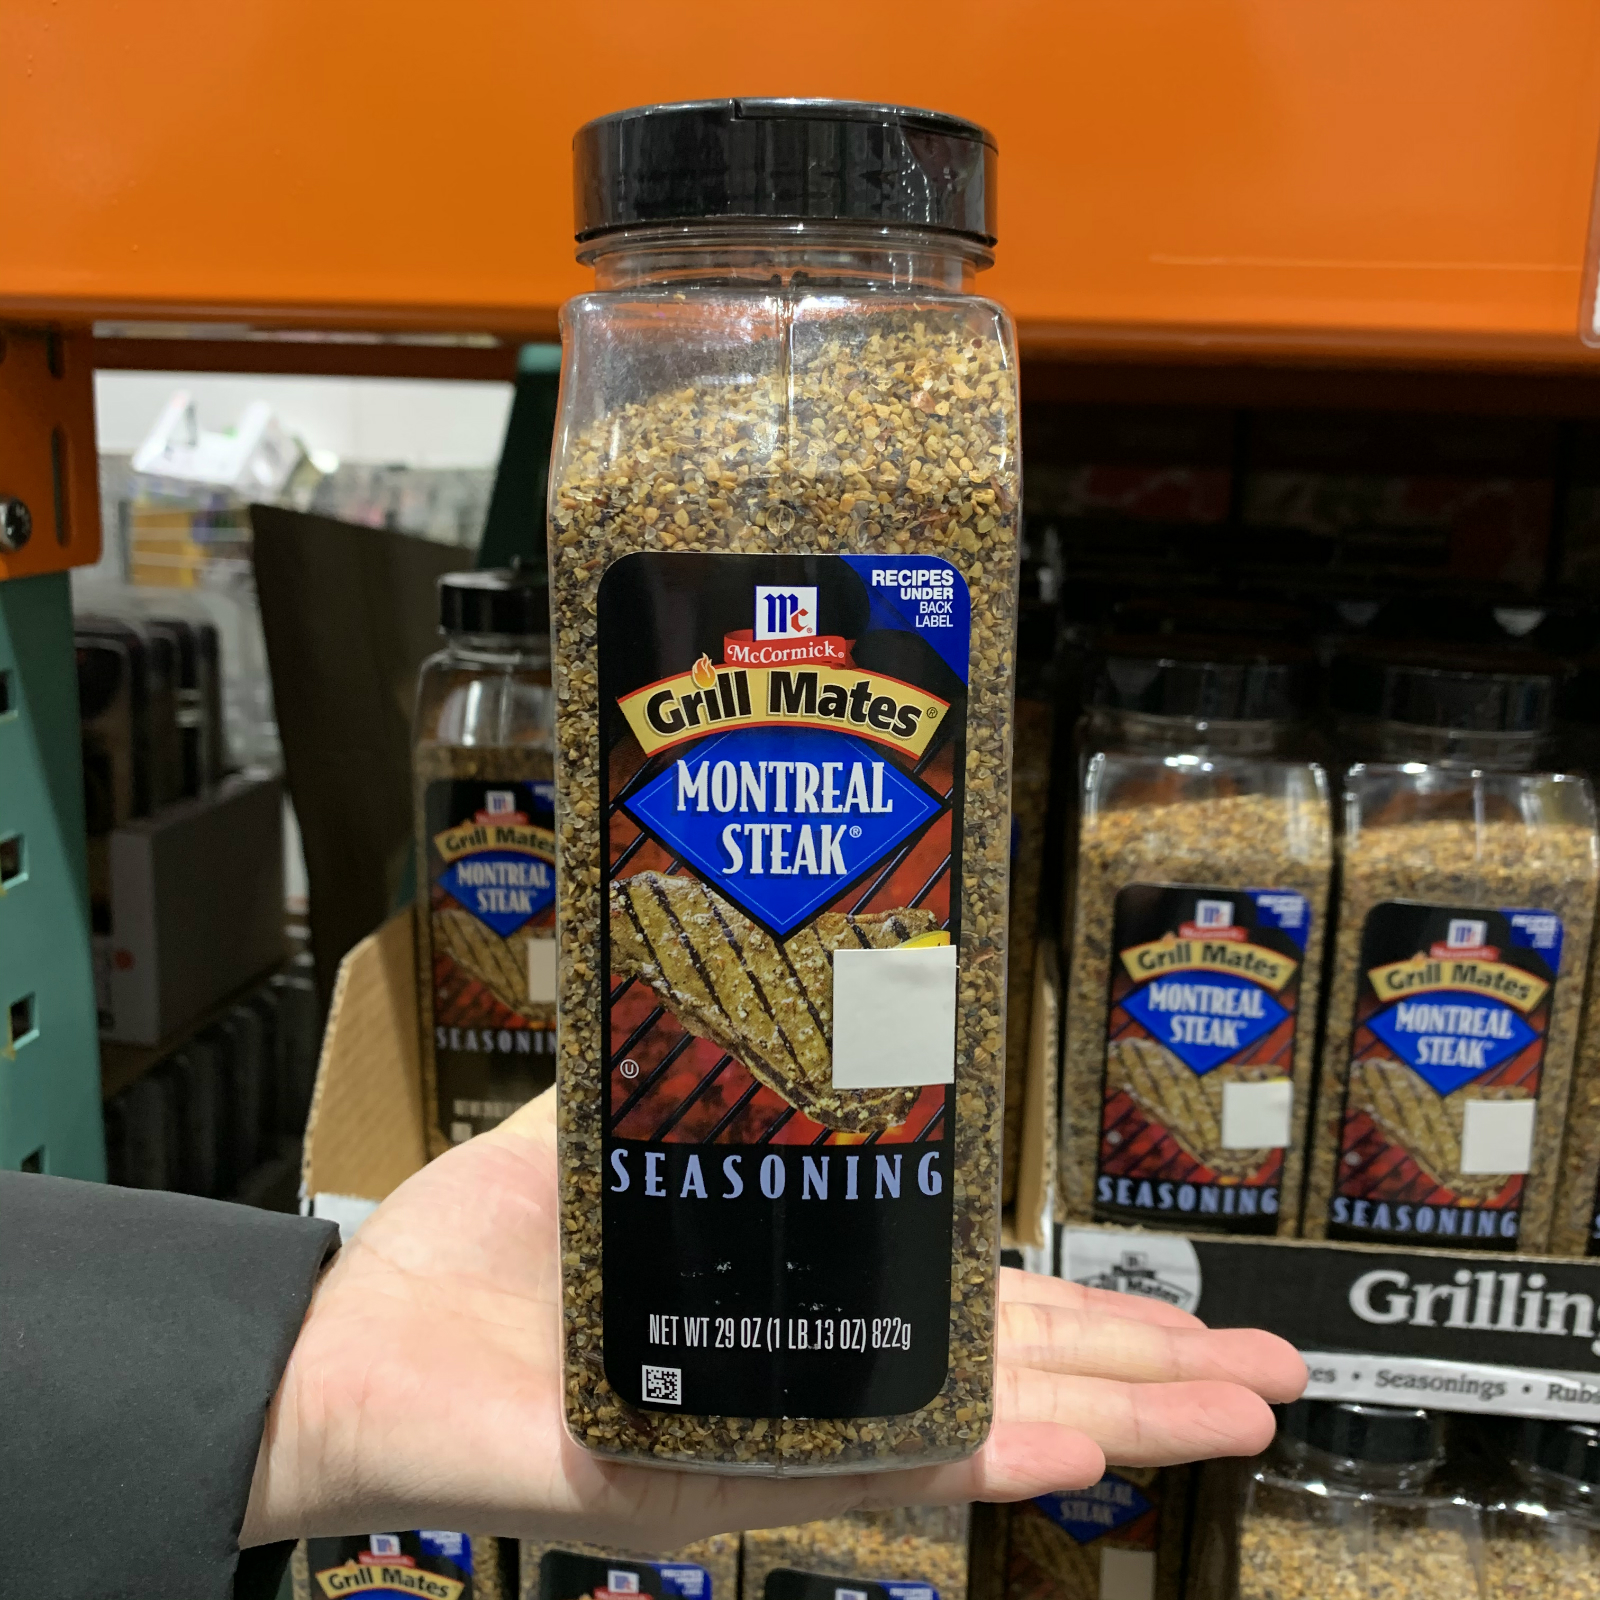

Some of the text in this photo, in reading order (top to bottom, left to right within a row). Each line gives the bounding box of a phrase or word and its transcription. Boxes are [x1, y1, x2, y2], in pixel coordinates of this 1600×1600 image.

[872, 570, 954, 586] RECIPES
[901, 587, 954, 600] UNDER
[915, 615, 954, 628] LABEL
[919, 602, 953, 614] BACK
[646, 670, 752, 737] Grill
[676, 759, 893, 813] MONTREAL
[446, 826, 488, 852] Grill
[458, 861, 551, 889] MONTREAL
[1137, 942, 1191, 972] Grill
[1386, 964, 1440, 991] Grill
[1148, 982, 1265, 1019] MONTREAL
[1395, 1002, 1515, 1039] MONTREAL
[436, 1026, 556, 1054] SEASONIN
[610, 1148, 943, 1200] SEASONING
[1098, 1175, 1279, 1214] SEASONING
[1332, 1197, 1518, 1238] SEASONING
[1349, 1269, 1600, 1357] Grillin
[649, 1314, 679, 1346] NET
[683, 1316, 710, 1348] WT
[715, 1317, 735, 1349] 29
[740, 1318, 762, 1348] OZ
[766, 1317, 781, 1352] (1
[815, 1318, 834, 1350] 13
[840, 1318, 867, 1353] OZ)
[871, 1317, 912, 1350] 822g
[1375, 1366, 1507, 1400] Seasonings
[328, 1567, 450, 1598] Grill Mates
